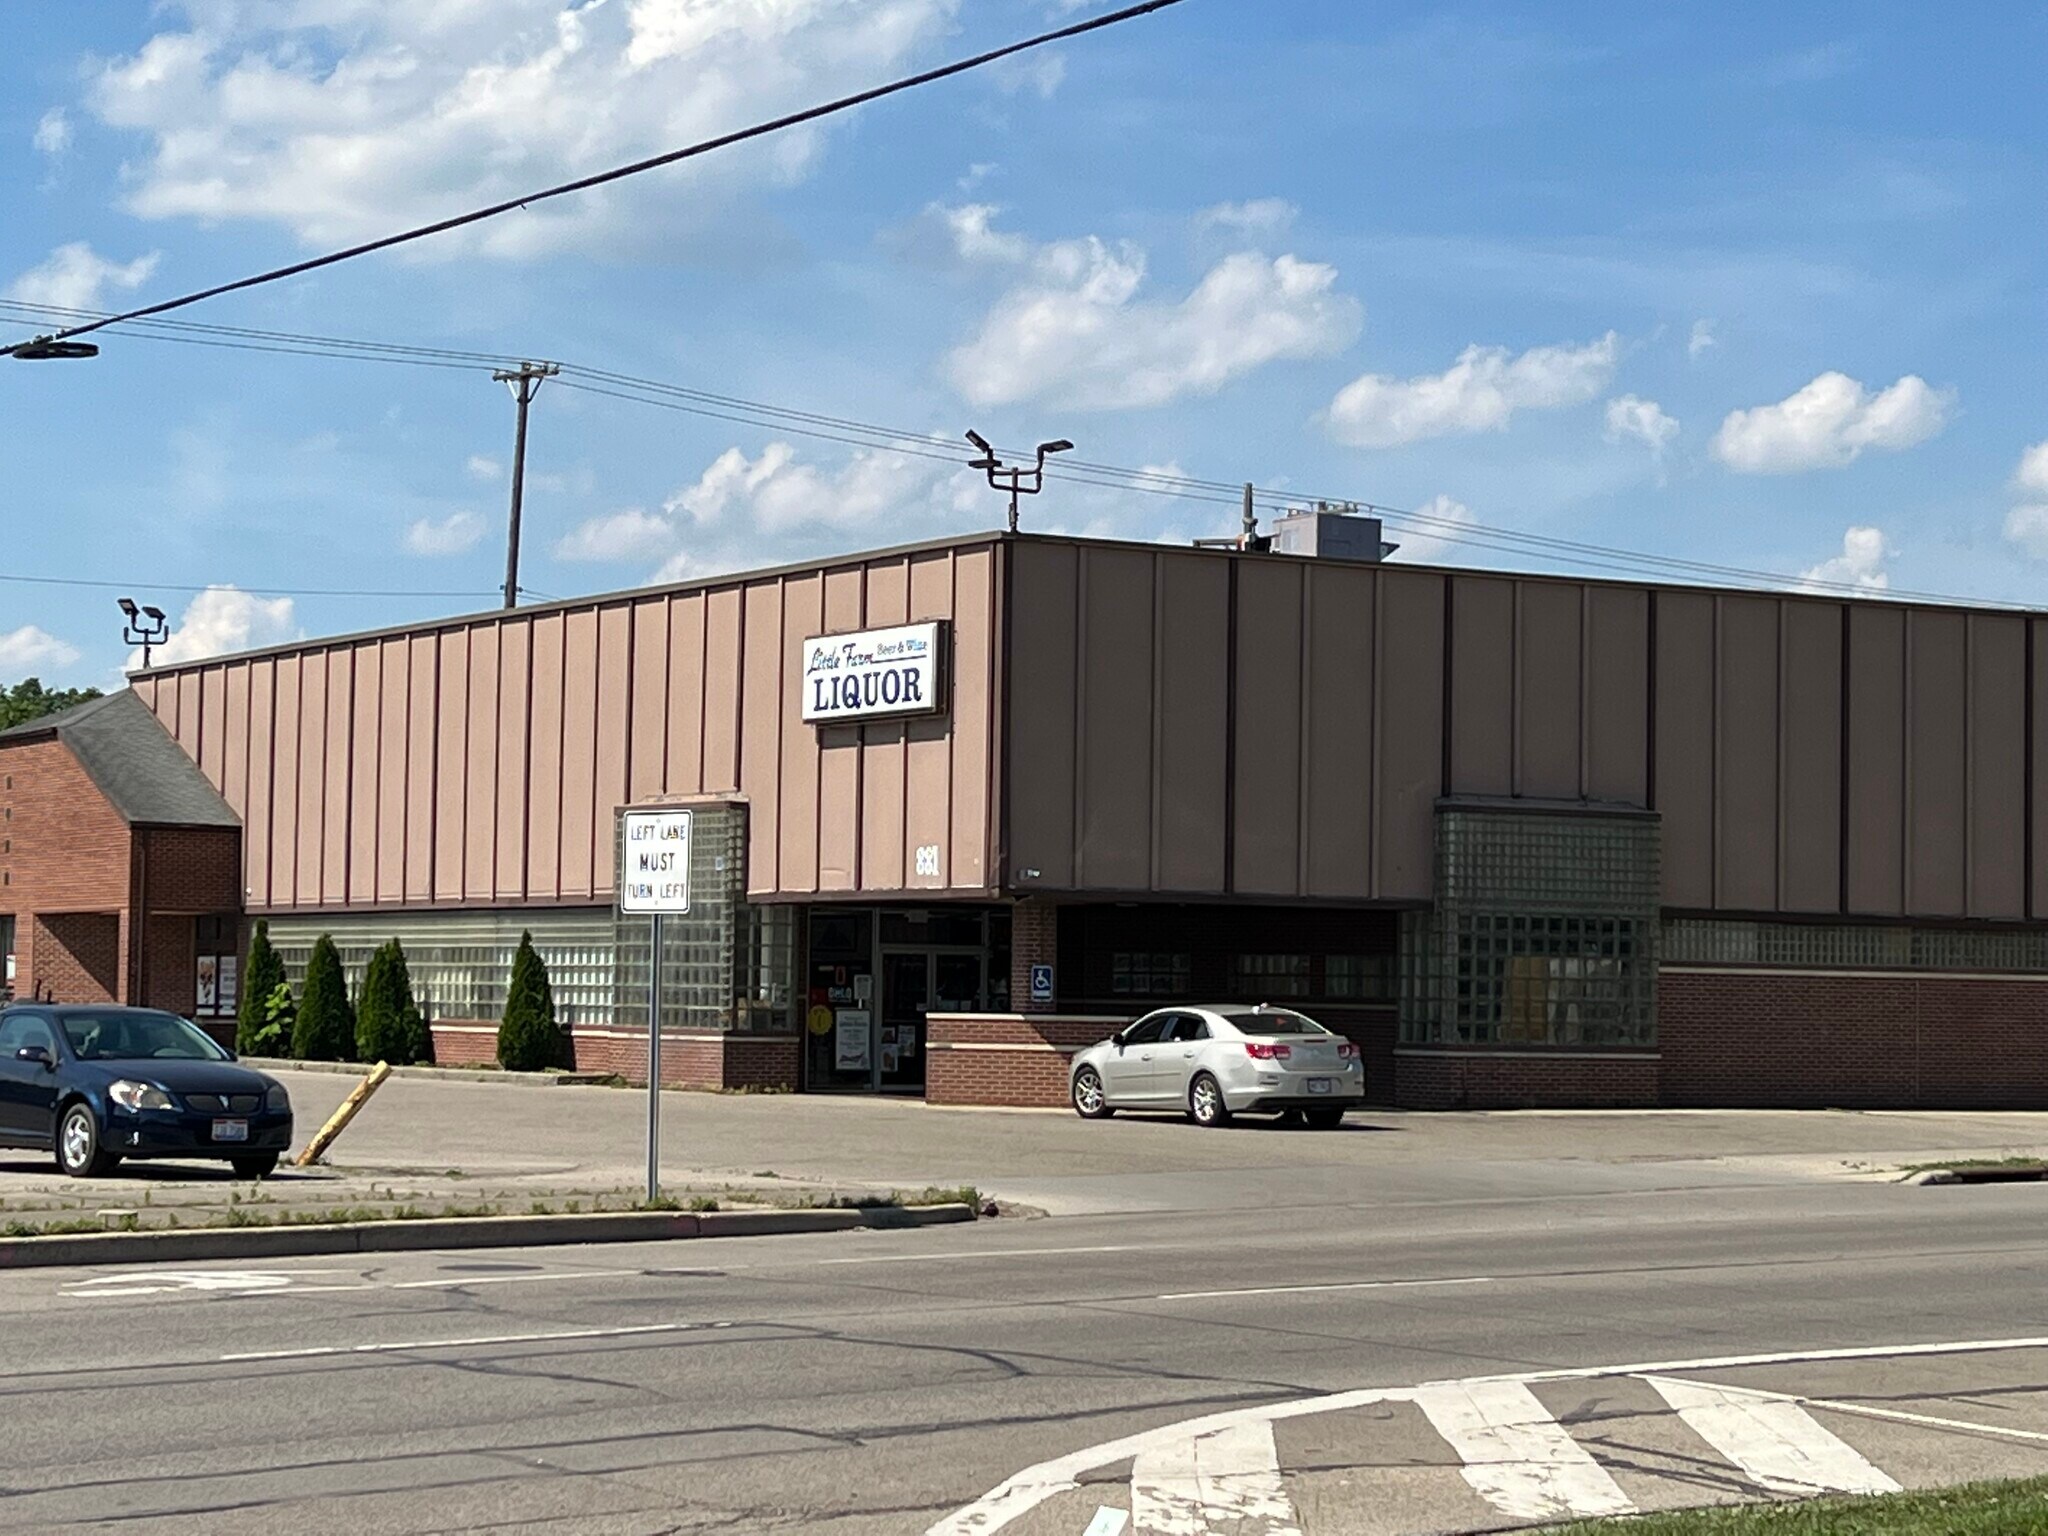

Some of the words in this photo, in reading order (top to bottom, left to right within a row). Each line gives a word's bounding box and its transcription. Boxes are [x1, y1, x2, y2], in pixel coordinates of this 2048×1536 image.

[877, 643, 896, 655] Beer
[897, 641, 904, 653] &
[906, 639, 928, 651] Wine
[806, 646, 840, 676] Little
[842, 643, 874, 668] Farm
[814, 667, 922, 711] LIQUOR
[631, 825, 655, 840] LEFT
[660, 825, 686, 841] LANE
[640, 852, 675, 872] MUST
[628, 884, 652, 899] TURN
[660, 884, 685, 899] LEFT
